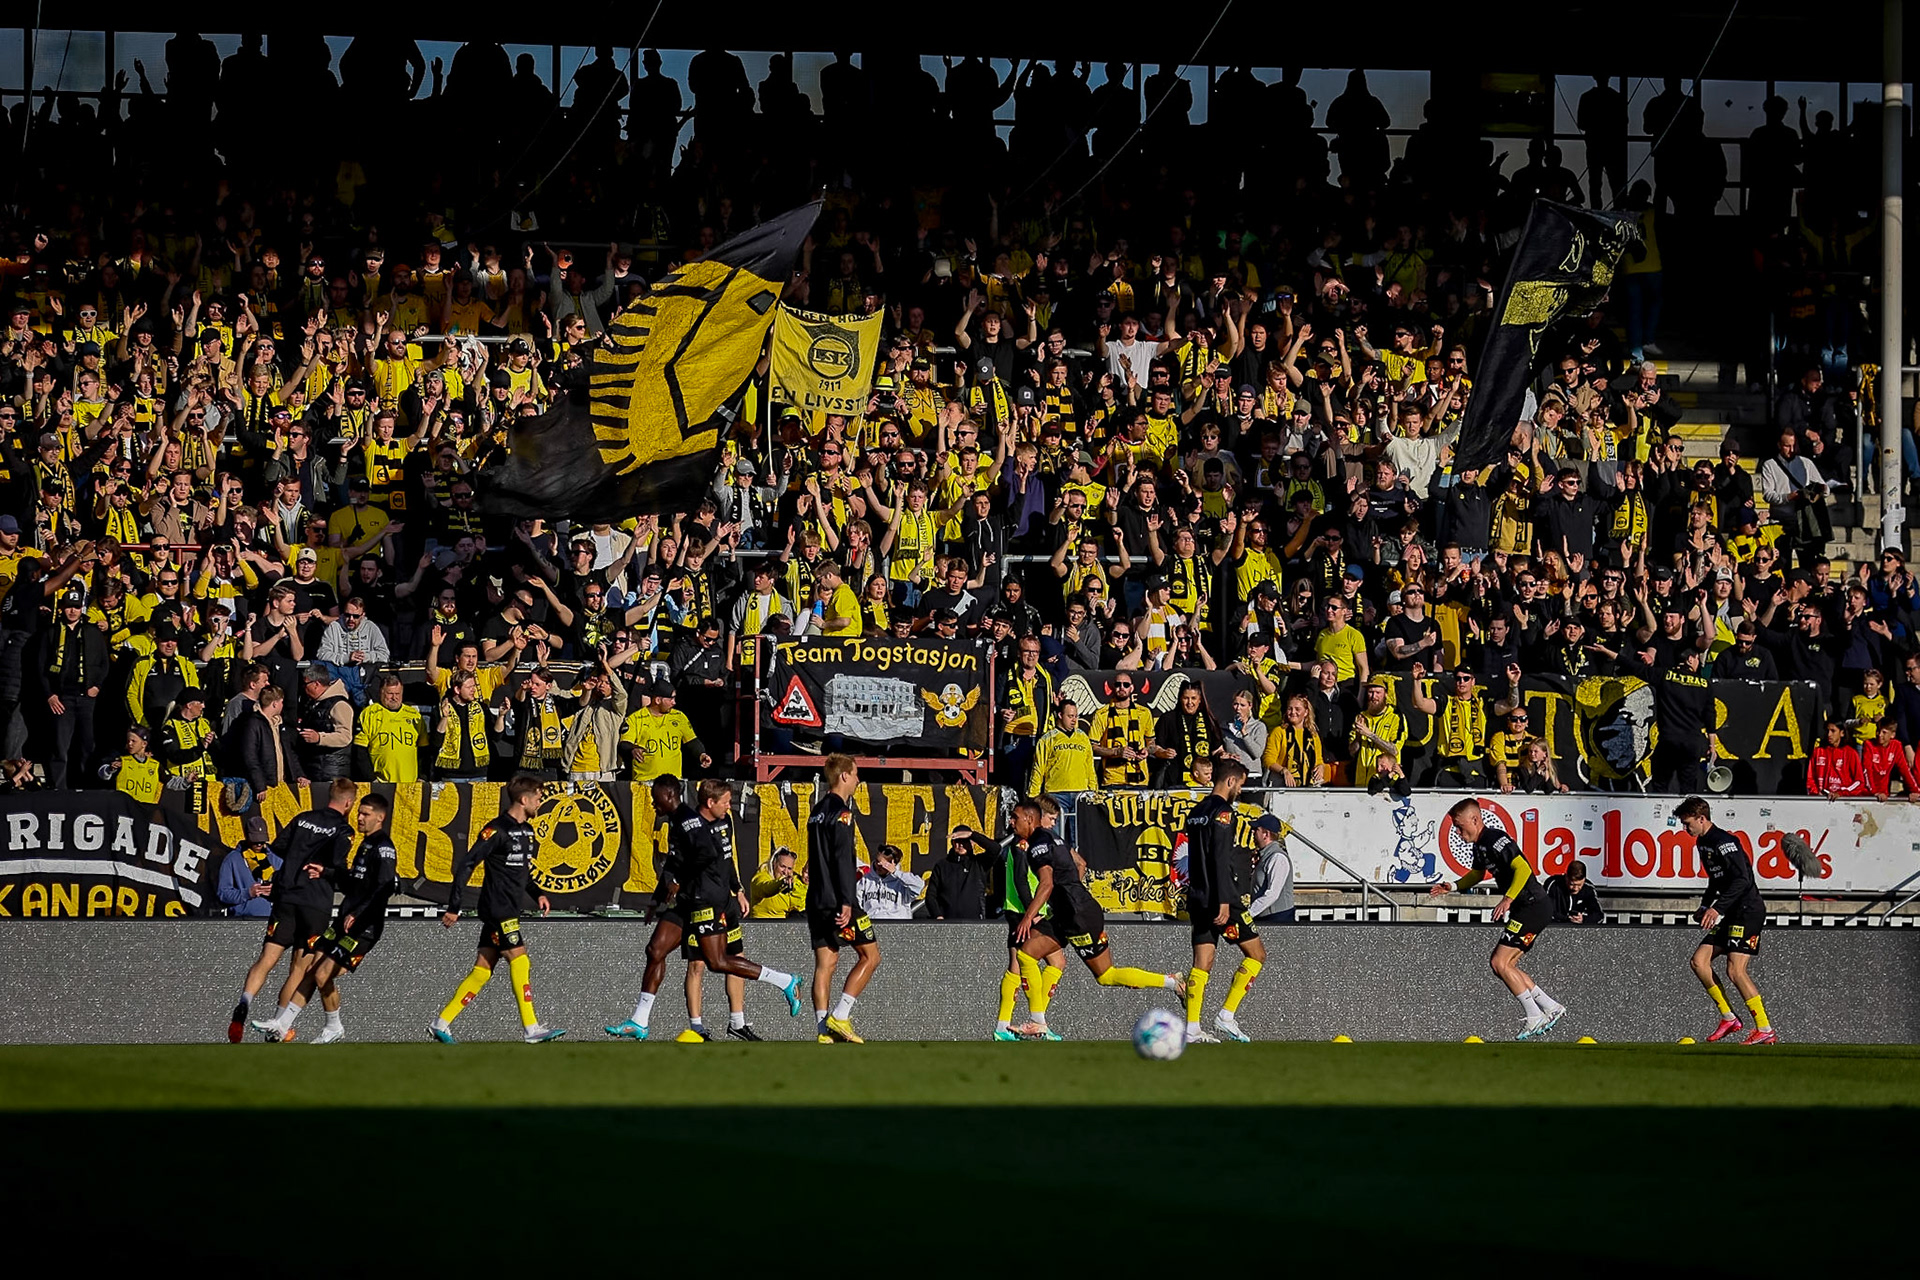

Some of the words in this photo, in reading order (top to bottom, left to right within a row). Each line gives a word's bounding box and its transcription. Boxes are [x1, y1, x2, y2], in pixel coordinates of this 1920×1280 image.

[813, 348, 849, 366] LSK
[771, 387, 796, 400] EN
[819, 380, 841, 391] 1917
[776, 641, 843, 667] Team
[1665, 670, 1708, 688] ULTRAS
[378, 727, 414, 751] DNB
[647, 731, 681, 758] DNB
[126, 777, 152, 797] DNB
